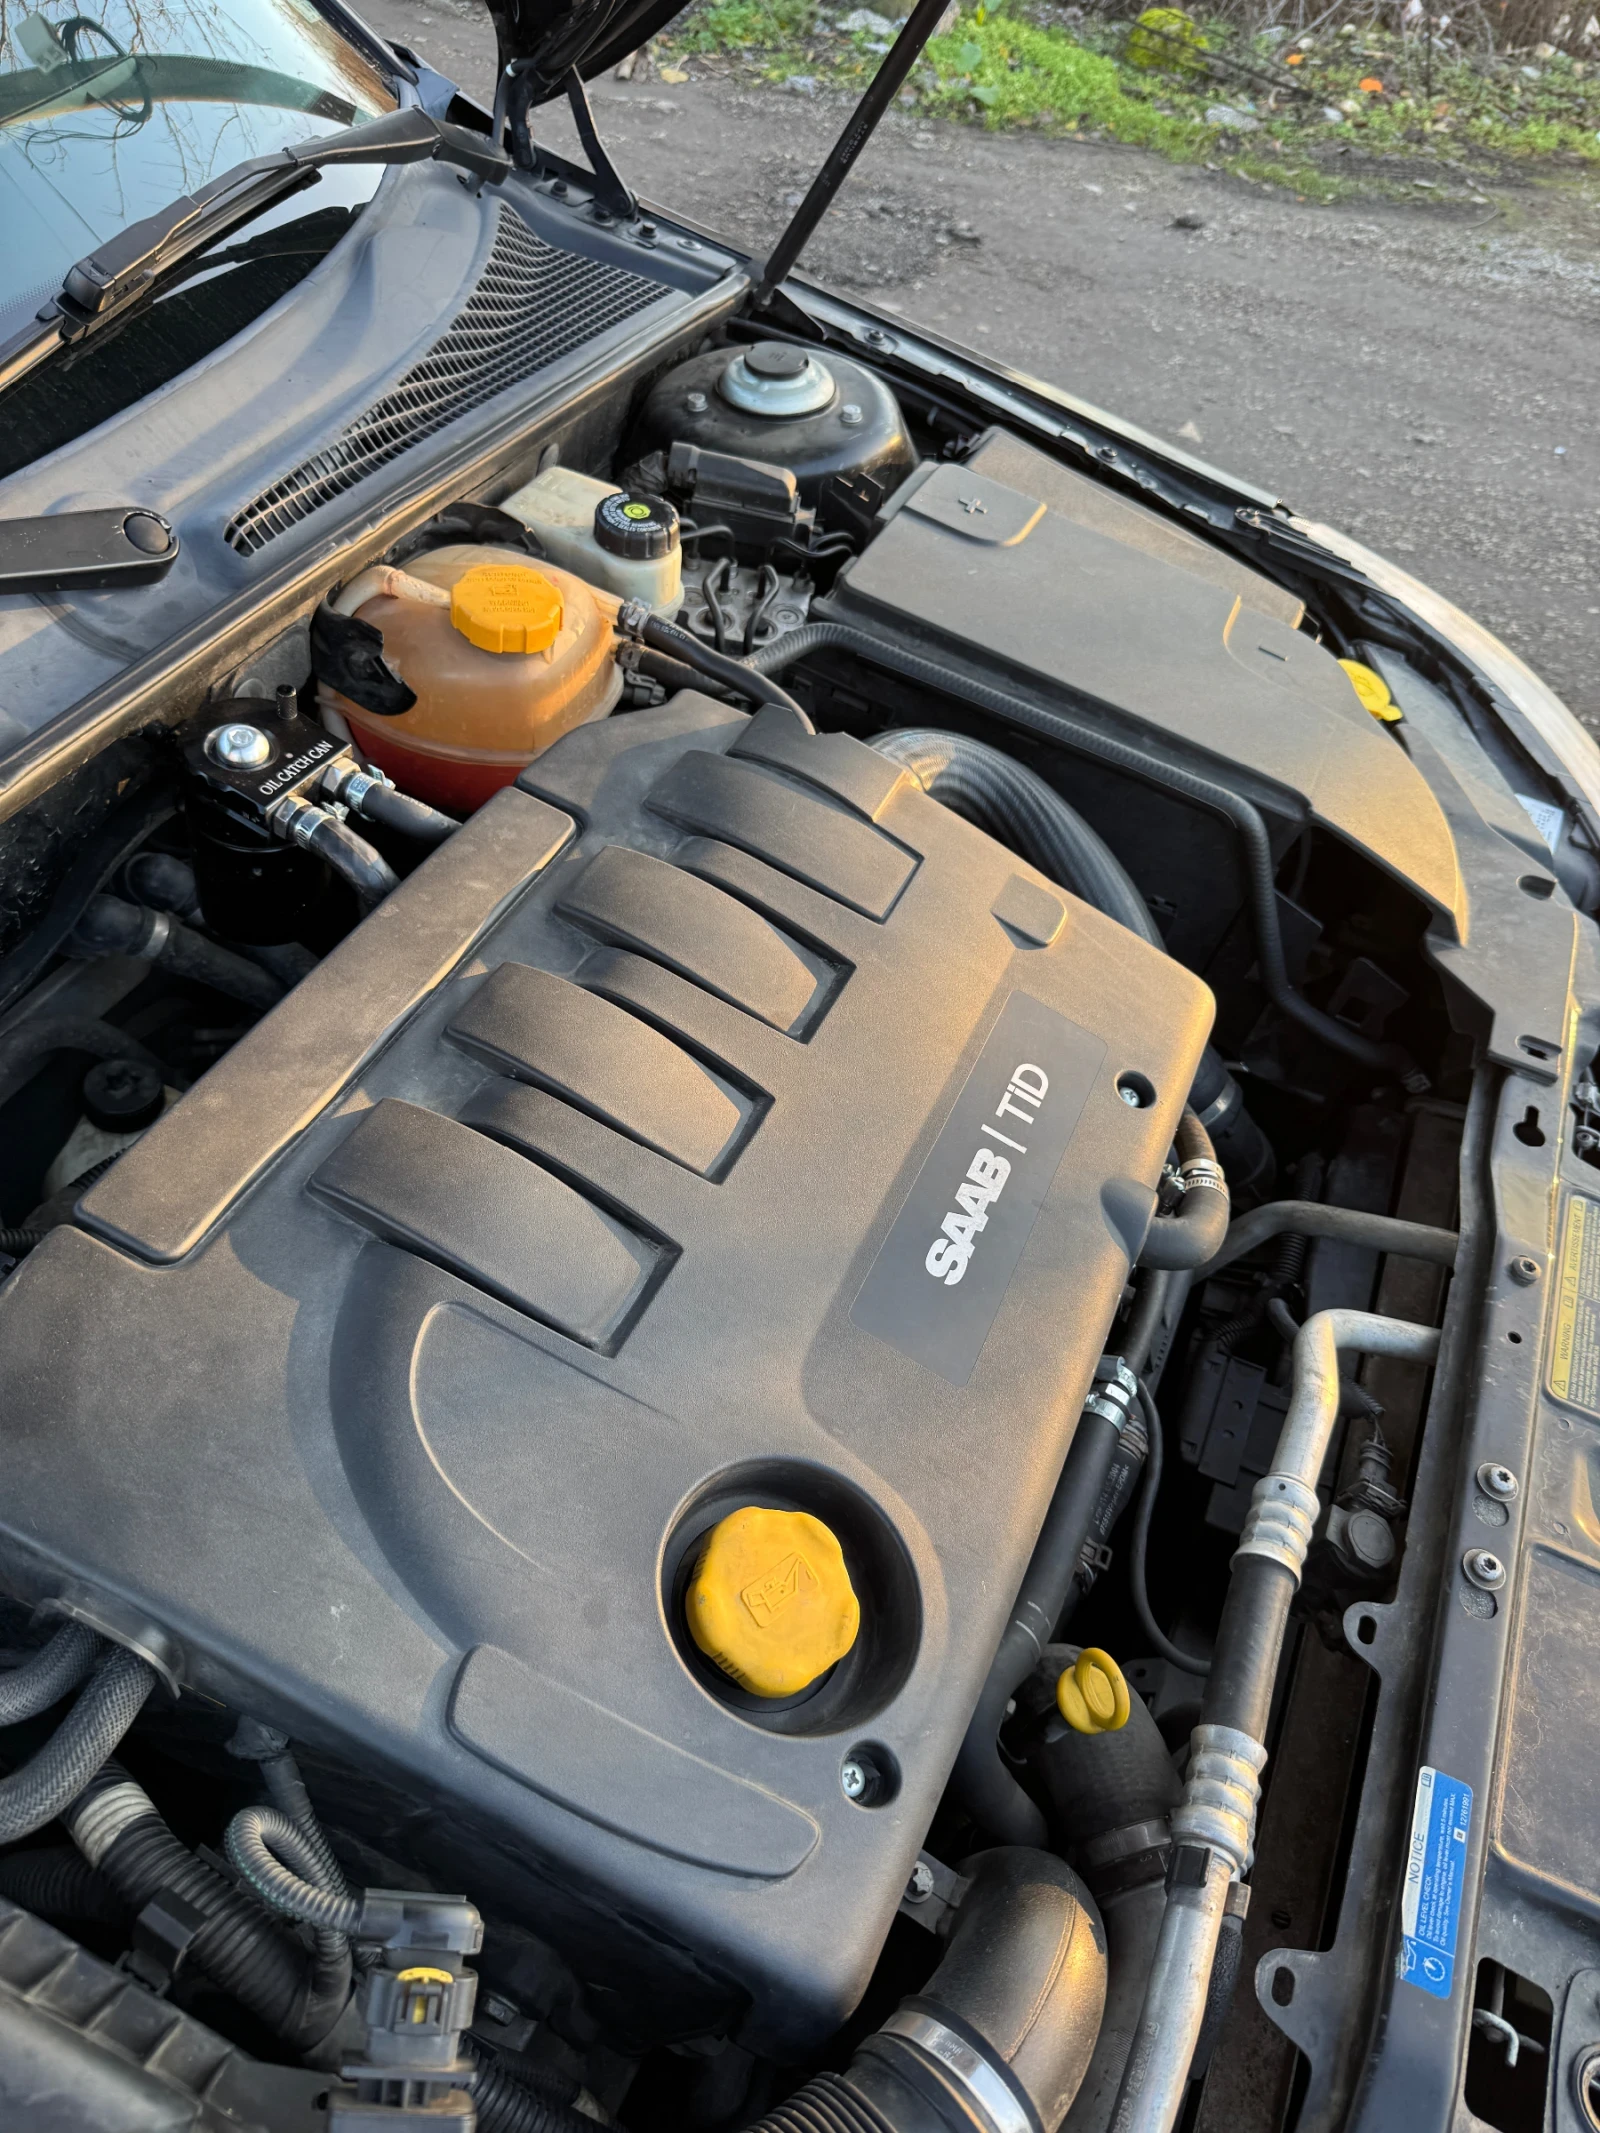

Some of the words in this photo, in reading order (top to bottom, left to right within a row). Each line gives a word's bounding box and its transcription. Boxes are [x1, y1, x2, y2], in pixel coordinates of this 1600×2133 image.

[259, 775, 284, 796] OIL
[277, 755, 312, 783] CATCH
[308, 739, 334, 761] CAN
[924, 1147, 1012, 1287] SAAB
[995, 1062, 1050, 1137] TiD
[1571, 1213, 1582, 1272] AVERTISSEMENT
[1560, 1324, 1572, 1361] WARNING
[1459, 1793, 1470, 1826] 12761991
[1408, 1833, 1426, 1884] NOTICE
[1423, 1874, 1431, 1900] CHECK
[1420, 1900, 1428, 1923] LEVEL
